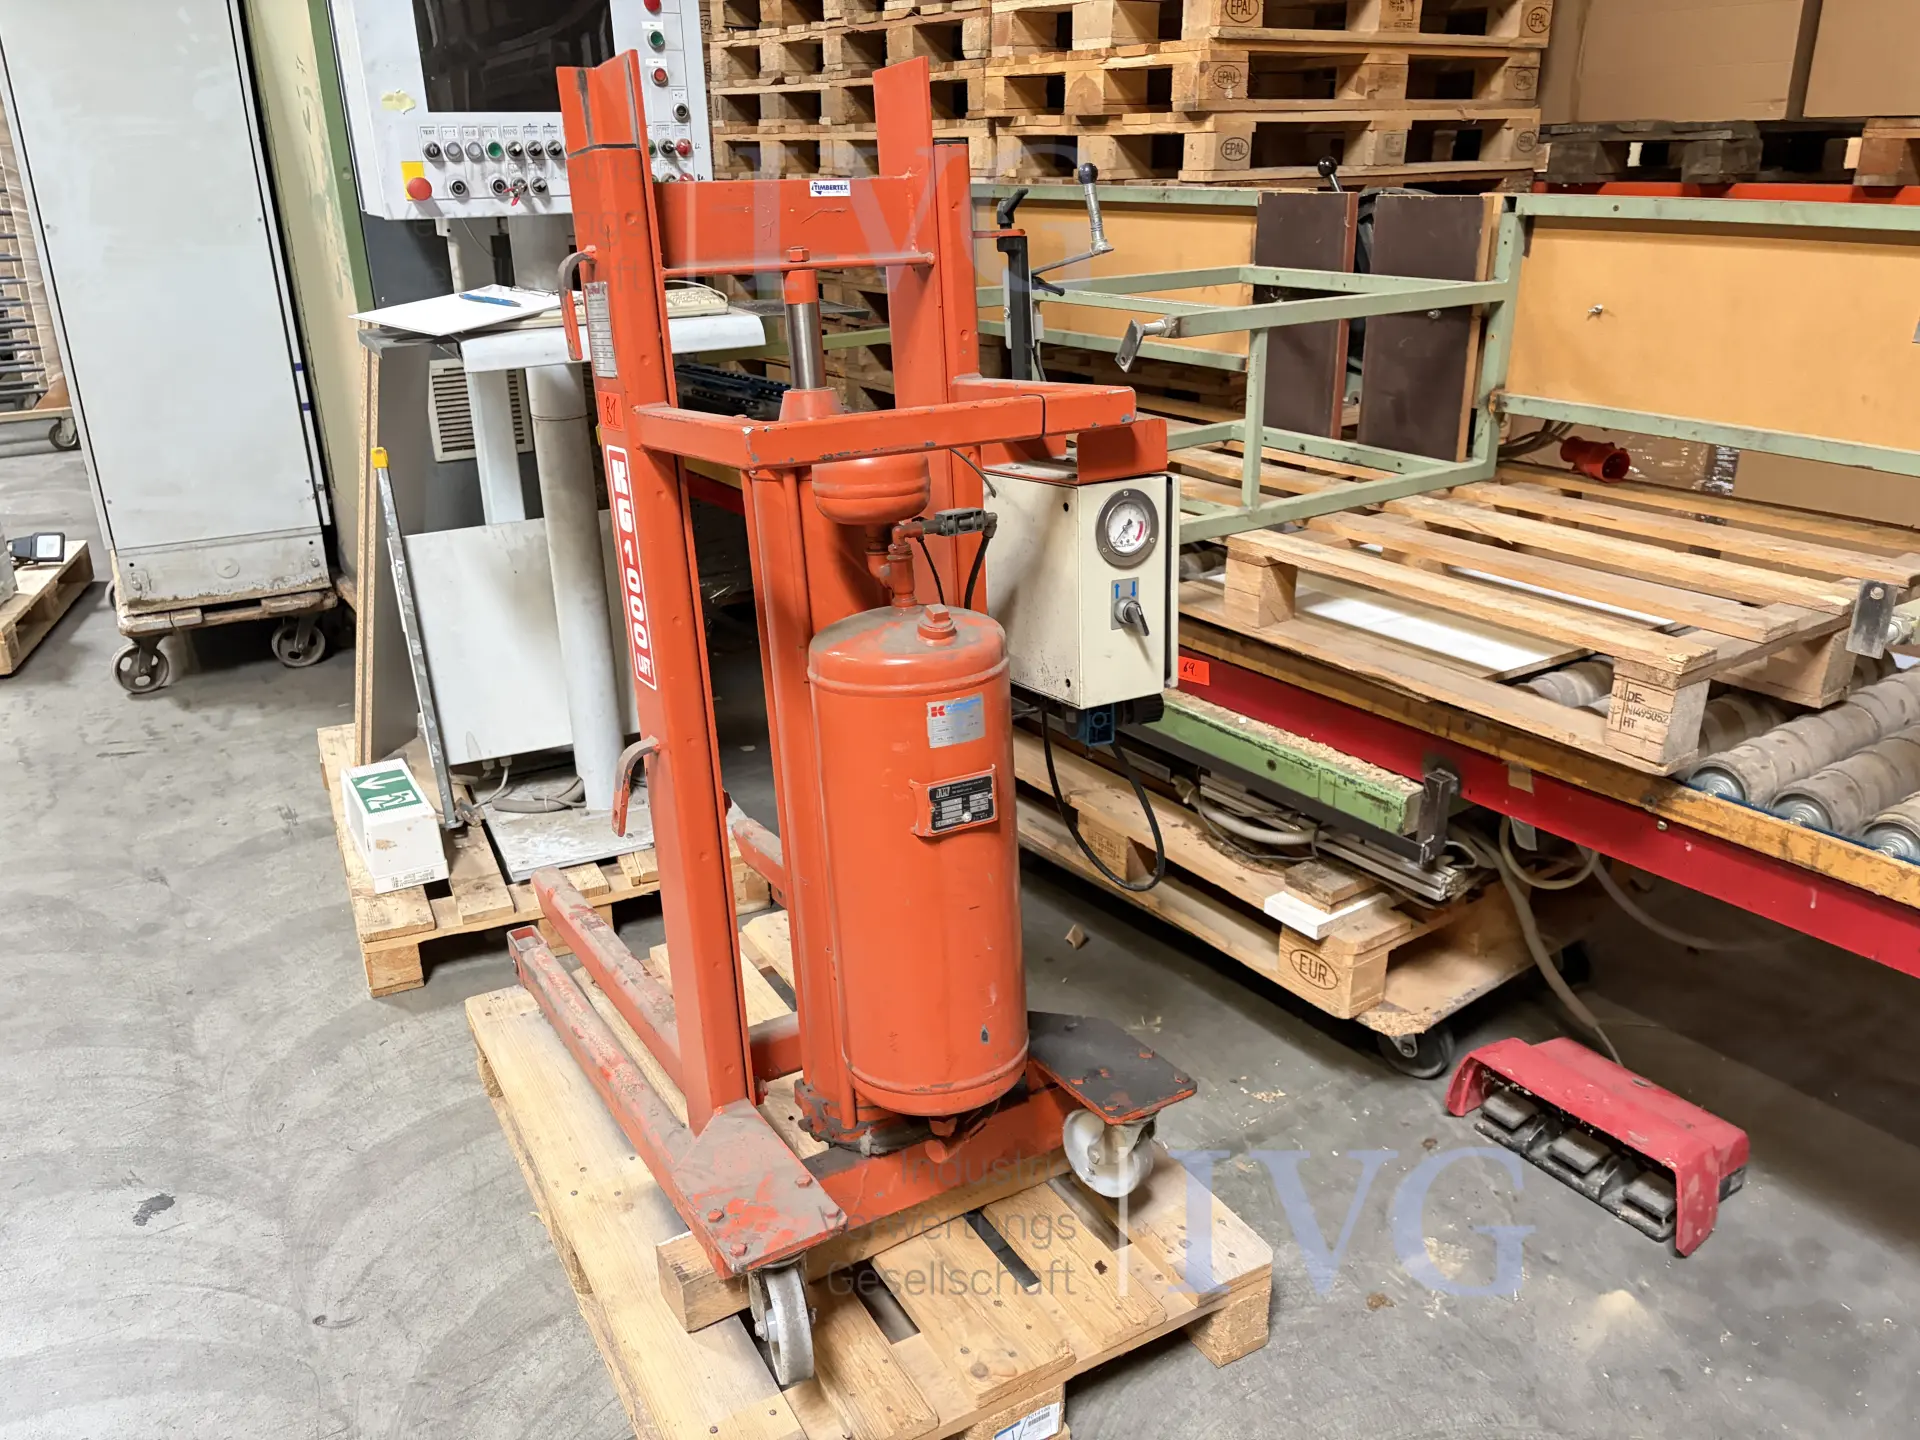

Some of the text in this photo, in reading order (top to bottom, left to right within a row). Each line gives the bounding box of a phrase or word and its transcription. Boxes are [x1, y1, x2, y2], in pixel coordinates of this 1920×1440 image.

[1231, 0, 1252, 16] EPAL
[1217, 71, 1240, 85] EPAL
[1225, 142, 1245, 156] EPAL
[1623, 716, 1637, 729] HT
[1299, 953, 1327, 986] EUR
